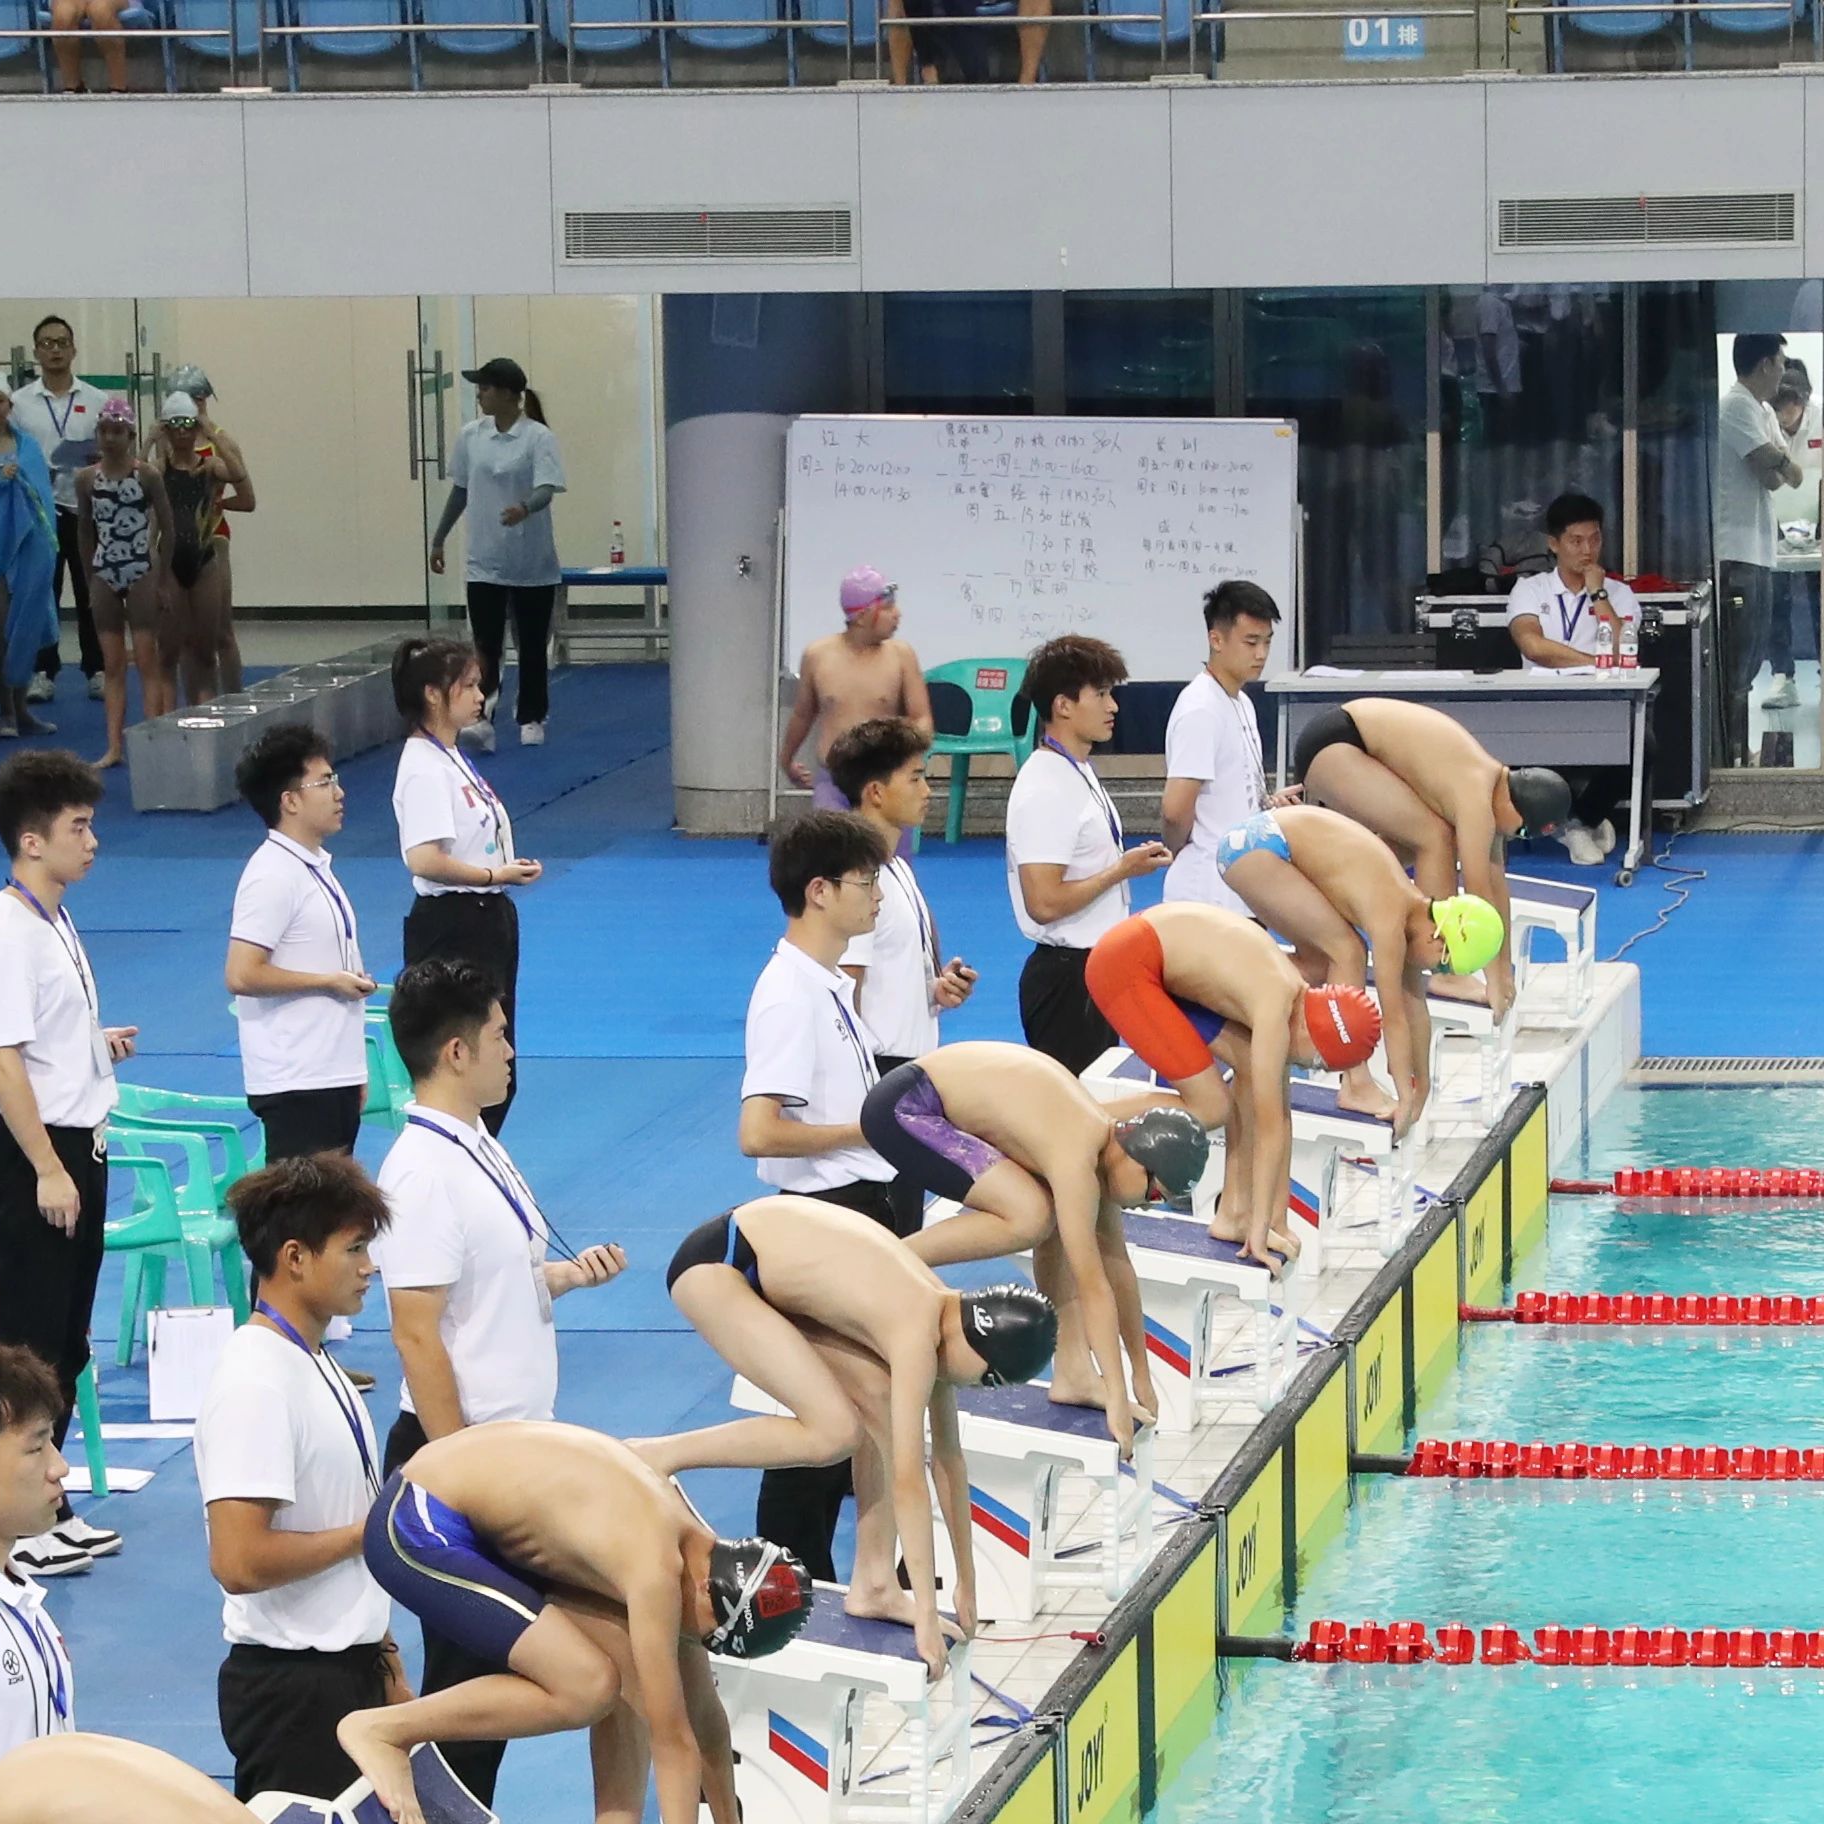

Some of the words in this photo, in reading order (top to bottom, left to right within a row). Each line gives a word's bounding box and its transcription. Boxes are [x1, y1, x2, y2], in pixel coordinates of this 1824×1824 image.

[1348, 18, 1418, 46] 01排
[1328, 998, 1353, 1044] SWANS
[1236, 1521, 1257, 1598] JOYI
[1078, 1722, 1104, 1813] JOYI
